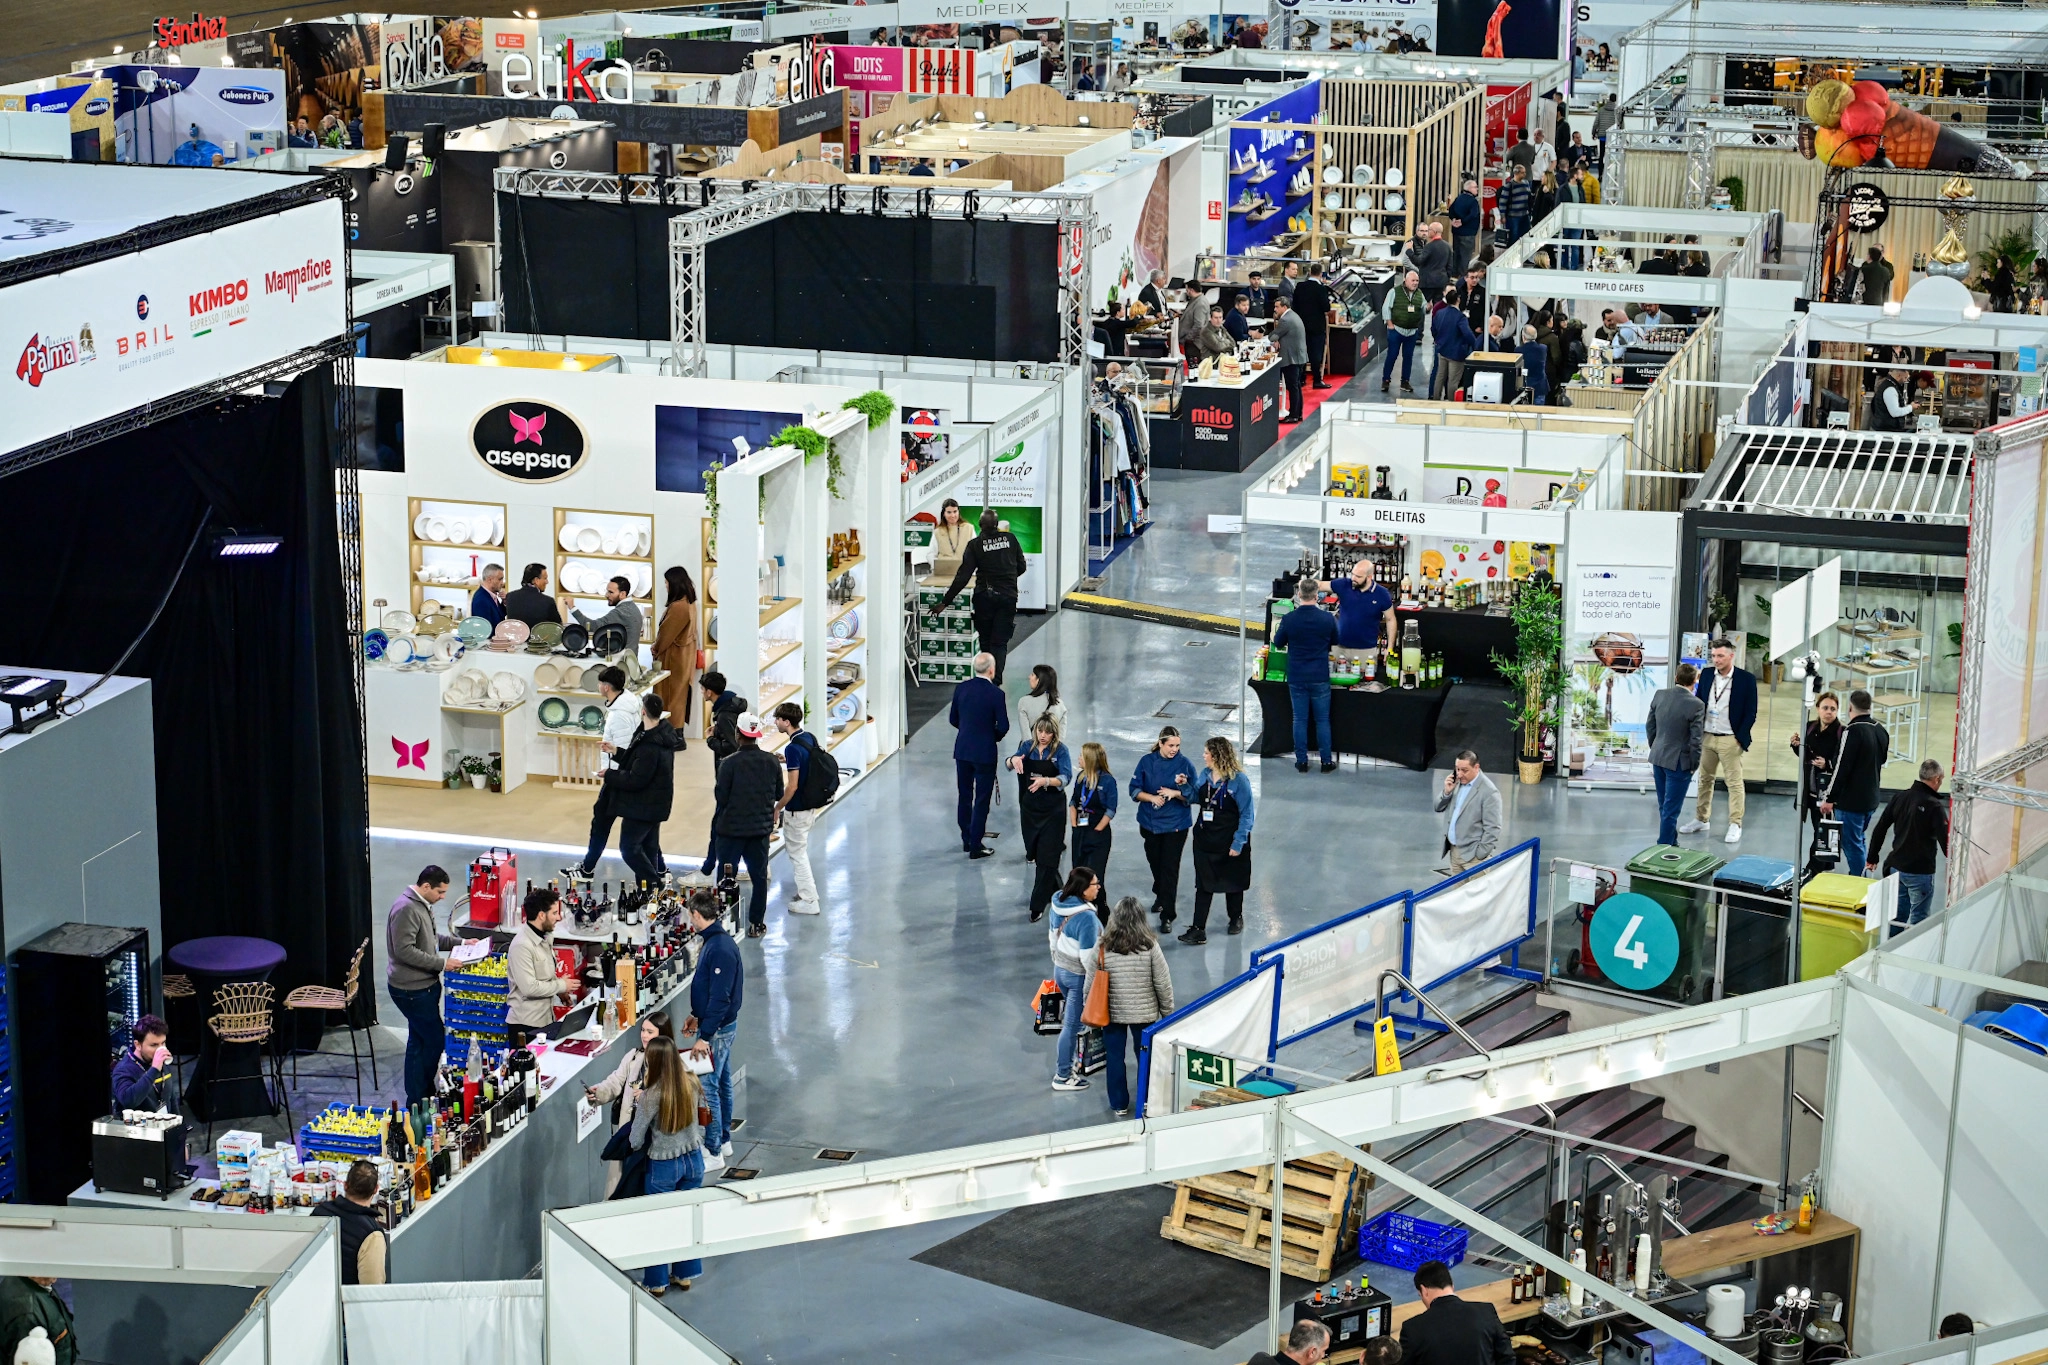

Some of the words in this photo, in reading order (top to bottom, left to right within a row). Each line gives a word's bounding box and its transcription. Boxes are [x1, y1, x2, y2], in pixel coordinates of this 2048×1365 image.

[936, 2, 1028, 18] MEDIPEIX
[1114, 2, 1174, 10] MEDIPEIX
[810, 15, 852, 27] MEDIPEIX
[157, 12, 228, 49] Sánchez
[577, 45, 602, 61] suinla
[501, 36, 634, 104] etika
[789, 36, 835, 103] etika
[222, 91, 251, 100] Jabones
[252, 91, 269, 103] Puig
[1584, 282, 1617, 292] TEMPLO
[1618, 283, 1644, 293] CAFES
[189, 278, 249, 317] KIMBO
[190, 312, 220, 331] ESPRESSO
[221, 303, 250, 321] ITALIANO
[116, 323, 174, 356] BRIL
[27, 336, 75, 377] Palma
[139, 355, 152, 365] FOOD
[153, 347, 175, 361] SERVICES
[1191, 405, 1234, 426] milo
[1194, 433, 1229, 442] SOLUTIONS
[486, 450, 572, 471] asepsia
[1446, 497, 1478, 506] deleitas
[1340, 508, 1355, 517] A53
[1374, 509, 1426, 524] DELEITAS
[982, 541, 1011, 553] KAIZEN
[1582, 589, 1594, 597] La
[1595, 589, 1627, 598] terraza
[1628, 589, 1641, 598] de
[1642, 590, 1652, 599] tu
[1582, 600, 1620, 611] negocio,
[1622, 600, 1661, 609] rentable
[1582, 610, 1603, 619] todo
[1604, 610, 1613, 619] el
[1614, 611, 1632, 619] año
[1613, 914, 1649, 970] 4
